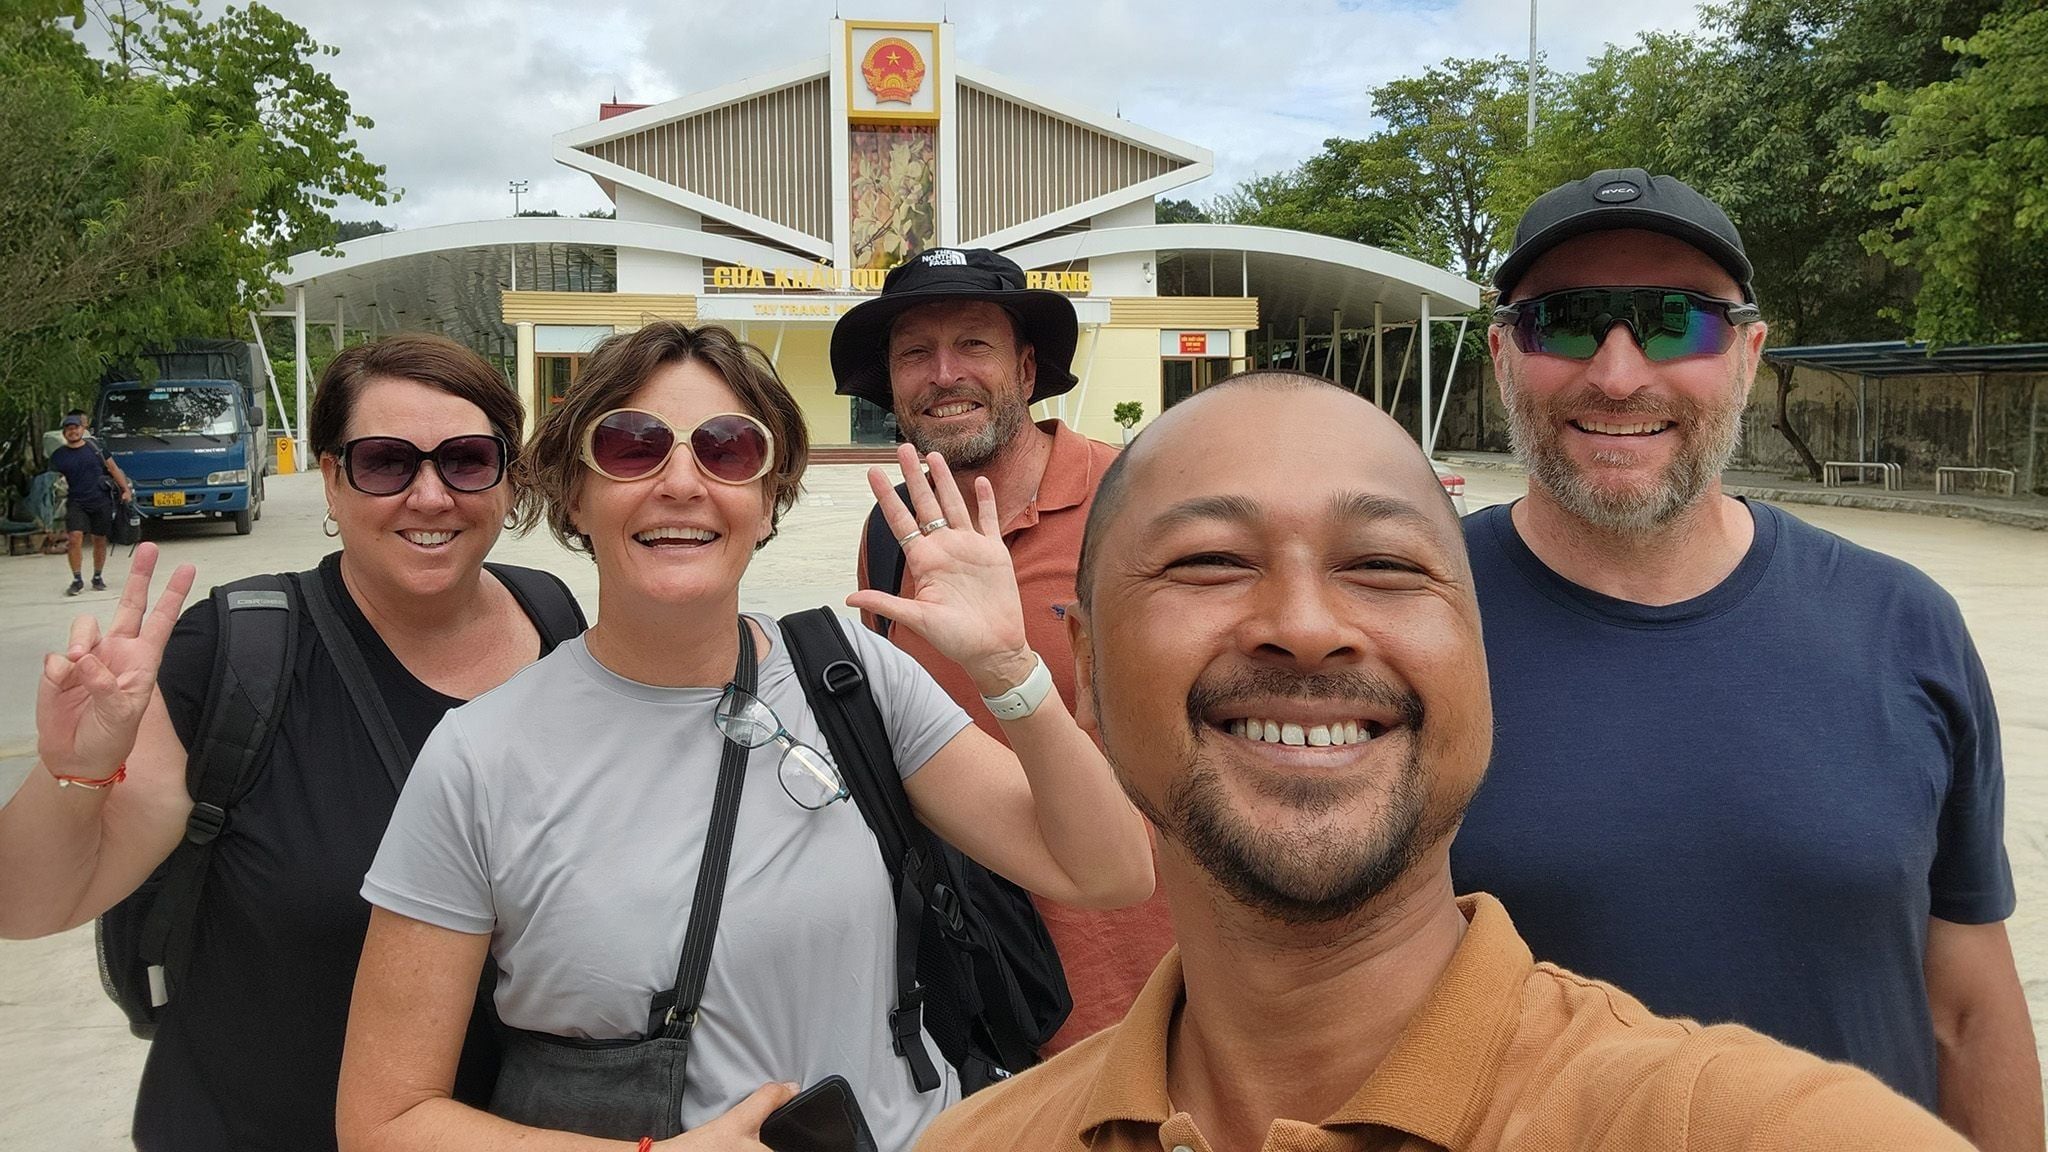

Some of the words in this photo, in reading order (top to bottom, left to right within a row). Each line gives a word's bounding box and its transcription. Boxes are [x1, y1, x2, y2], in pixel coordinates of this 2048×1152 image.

[922, 254, 952, 263] NORTH
[929, 259, 953, 267] FACE
[852, 268, 885, 292] QU
[1026, 270, 1093, 292] RANG
[753, 303, 778, 316] TAY
[780, 303, 831, 317] TRANG
